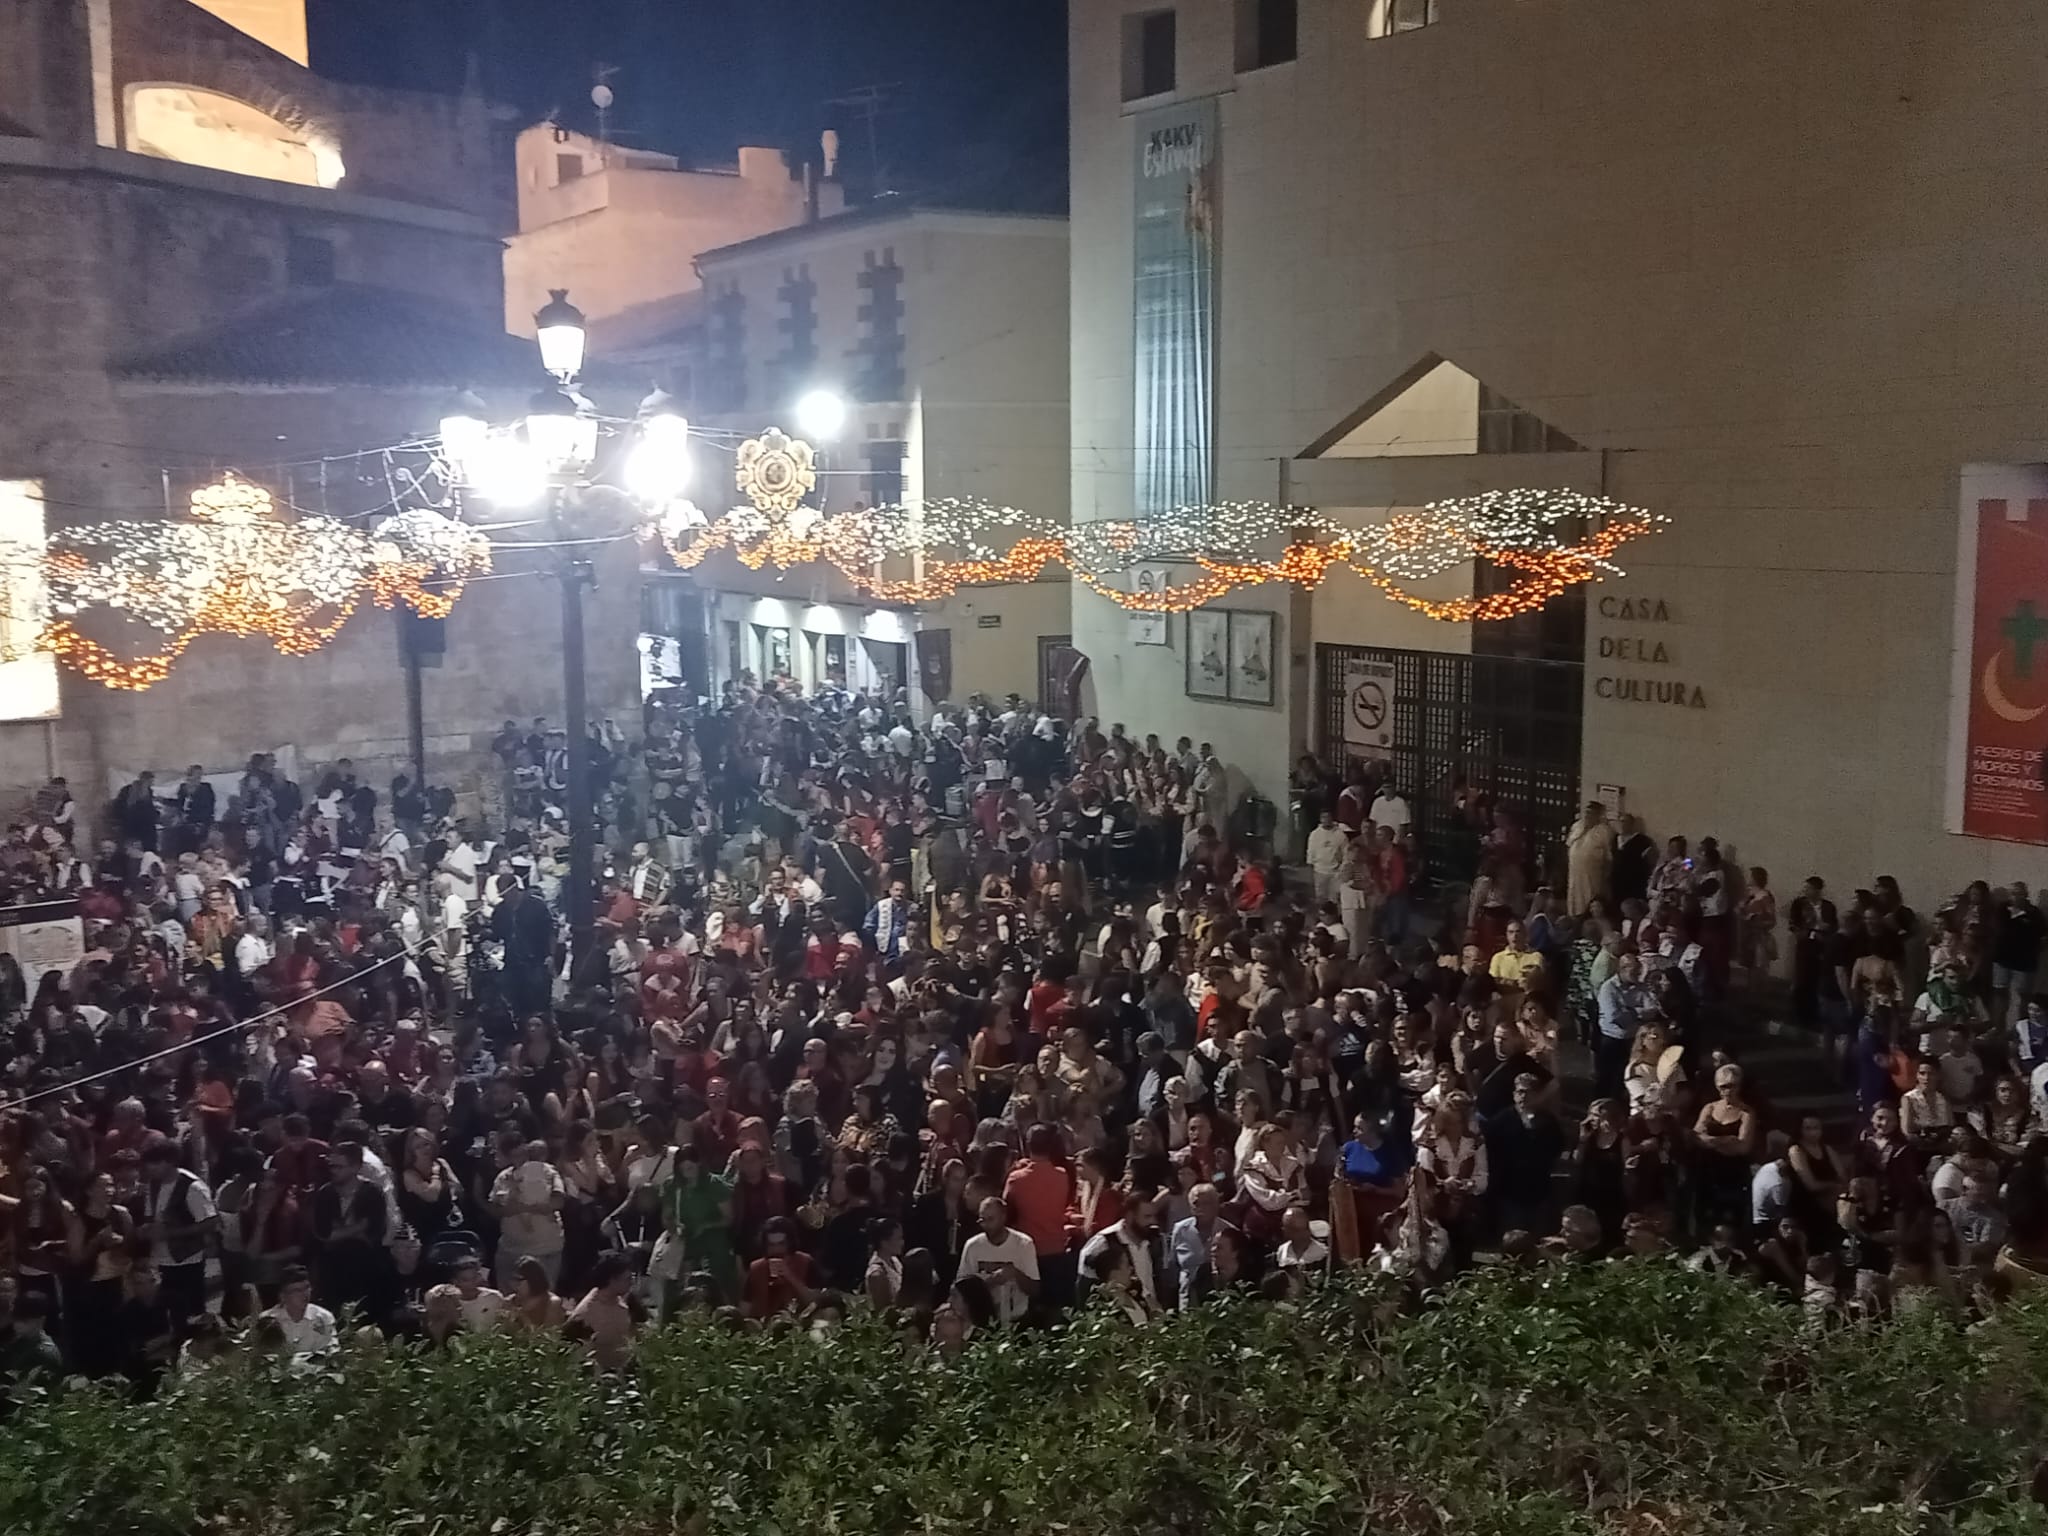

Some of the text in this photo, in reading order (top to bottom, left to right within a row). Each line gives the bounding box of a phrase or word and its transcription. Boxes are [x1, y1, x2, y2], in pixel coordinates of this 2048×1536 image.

[1599, 596, 1669, 622] CASA
[1600, 636, 1669, 663] DE LA
[1596, 676, 1706, 708] CULTURA
[1974, 745, 2044, 762] FIESTAS DE
[1973, 759, 2033, 775] MOROS Y
[1971, 773, 2045, 791] CRISTIANOS
